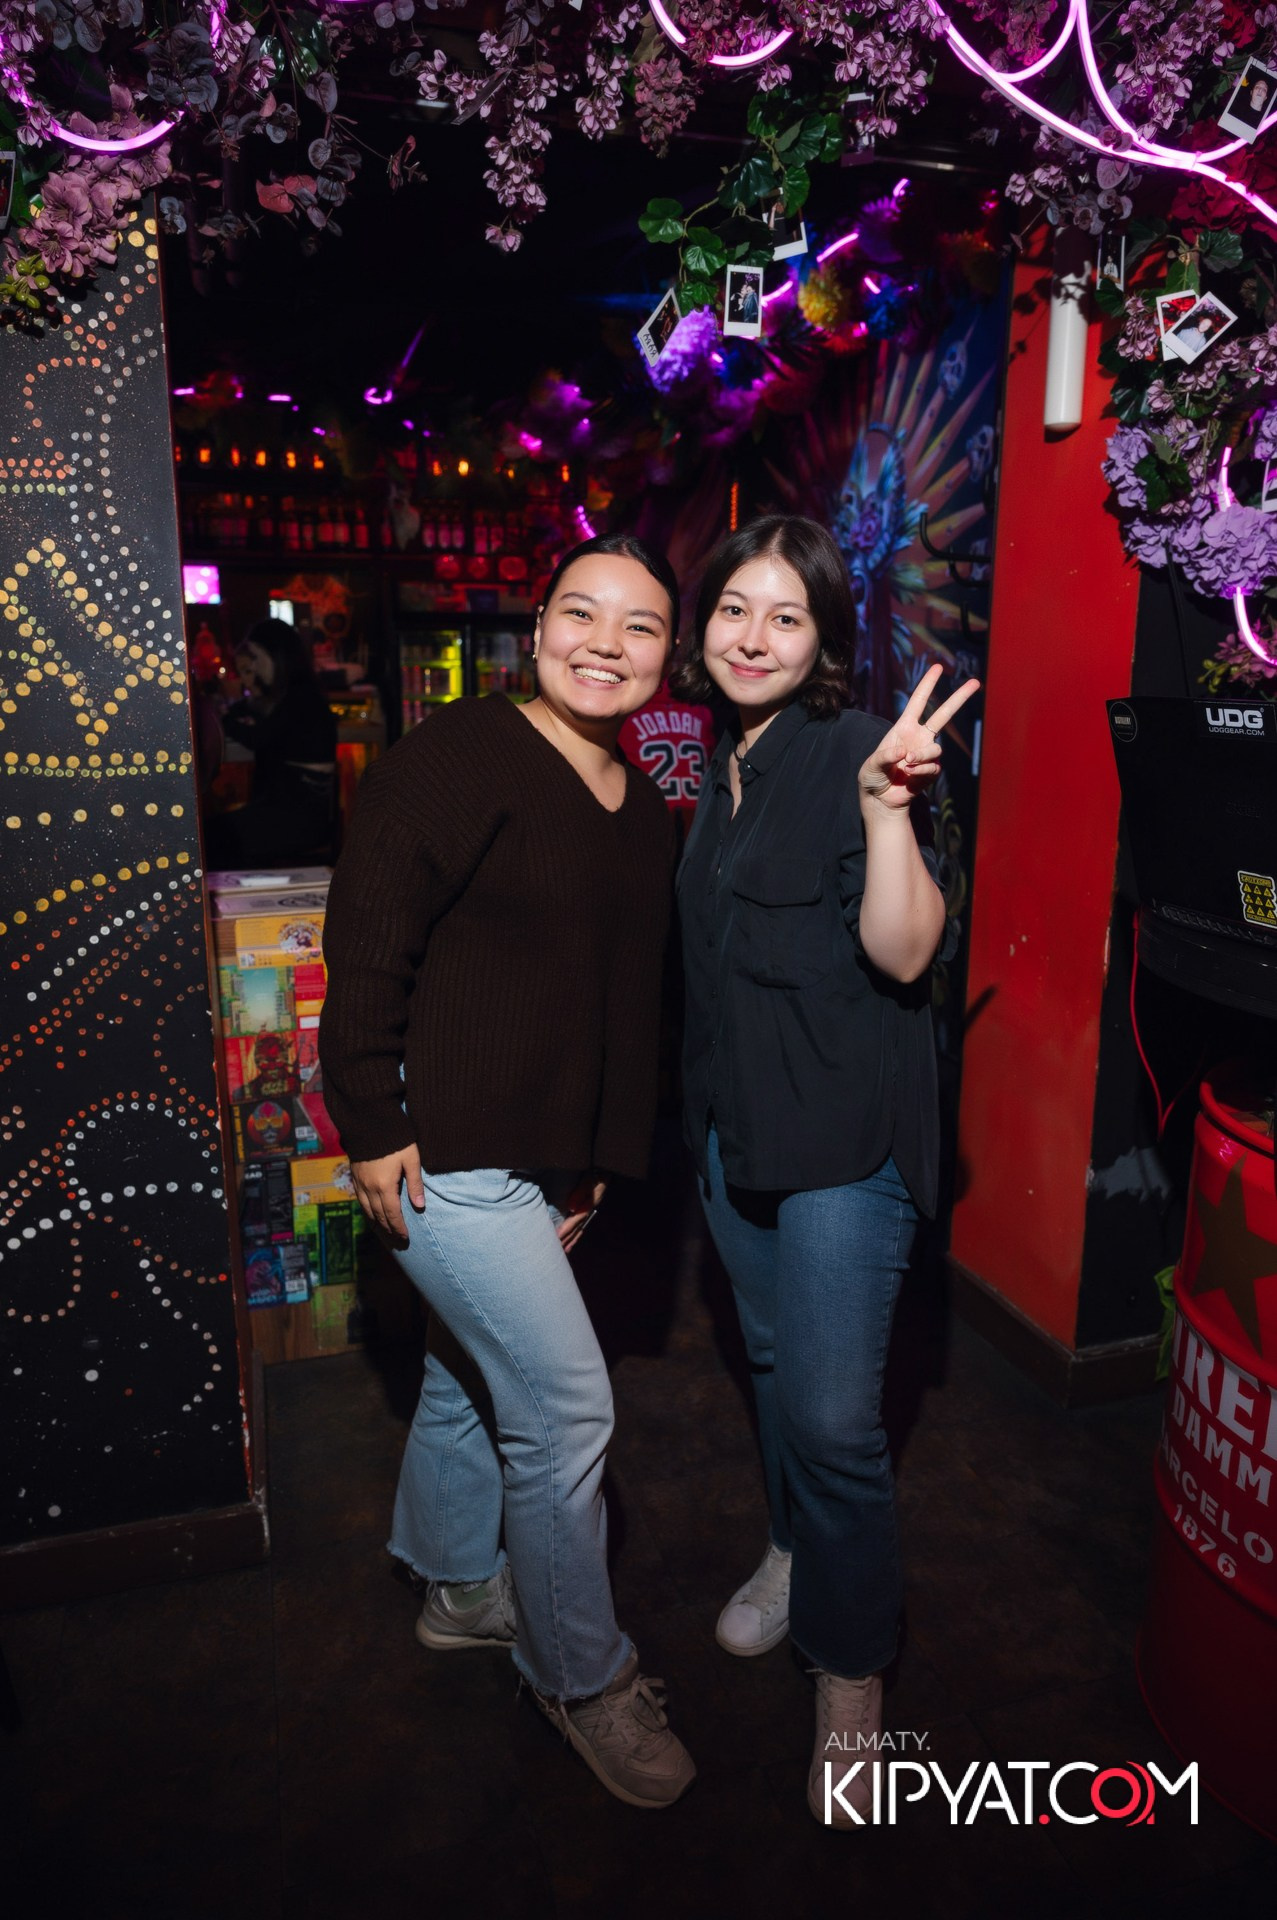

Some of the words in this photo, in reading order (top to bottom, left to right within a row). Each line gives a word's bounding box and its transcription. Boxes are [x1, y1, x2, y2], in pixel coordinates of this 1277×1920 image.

[632, 711, 702, 741] JORDAN
[1208, 726, 1265, 736] UDGGEAR.COM
[639, 740, 708, 800] 23
[1171, 1384, 1273, 1508] DAMM
[1161, 1410, 1275, 1565] ARCELO
[1173, 1503, 1238, 1580] 1876
